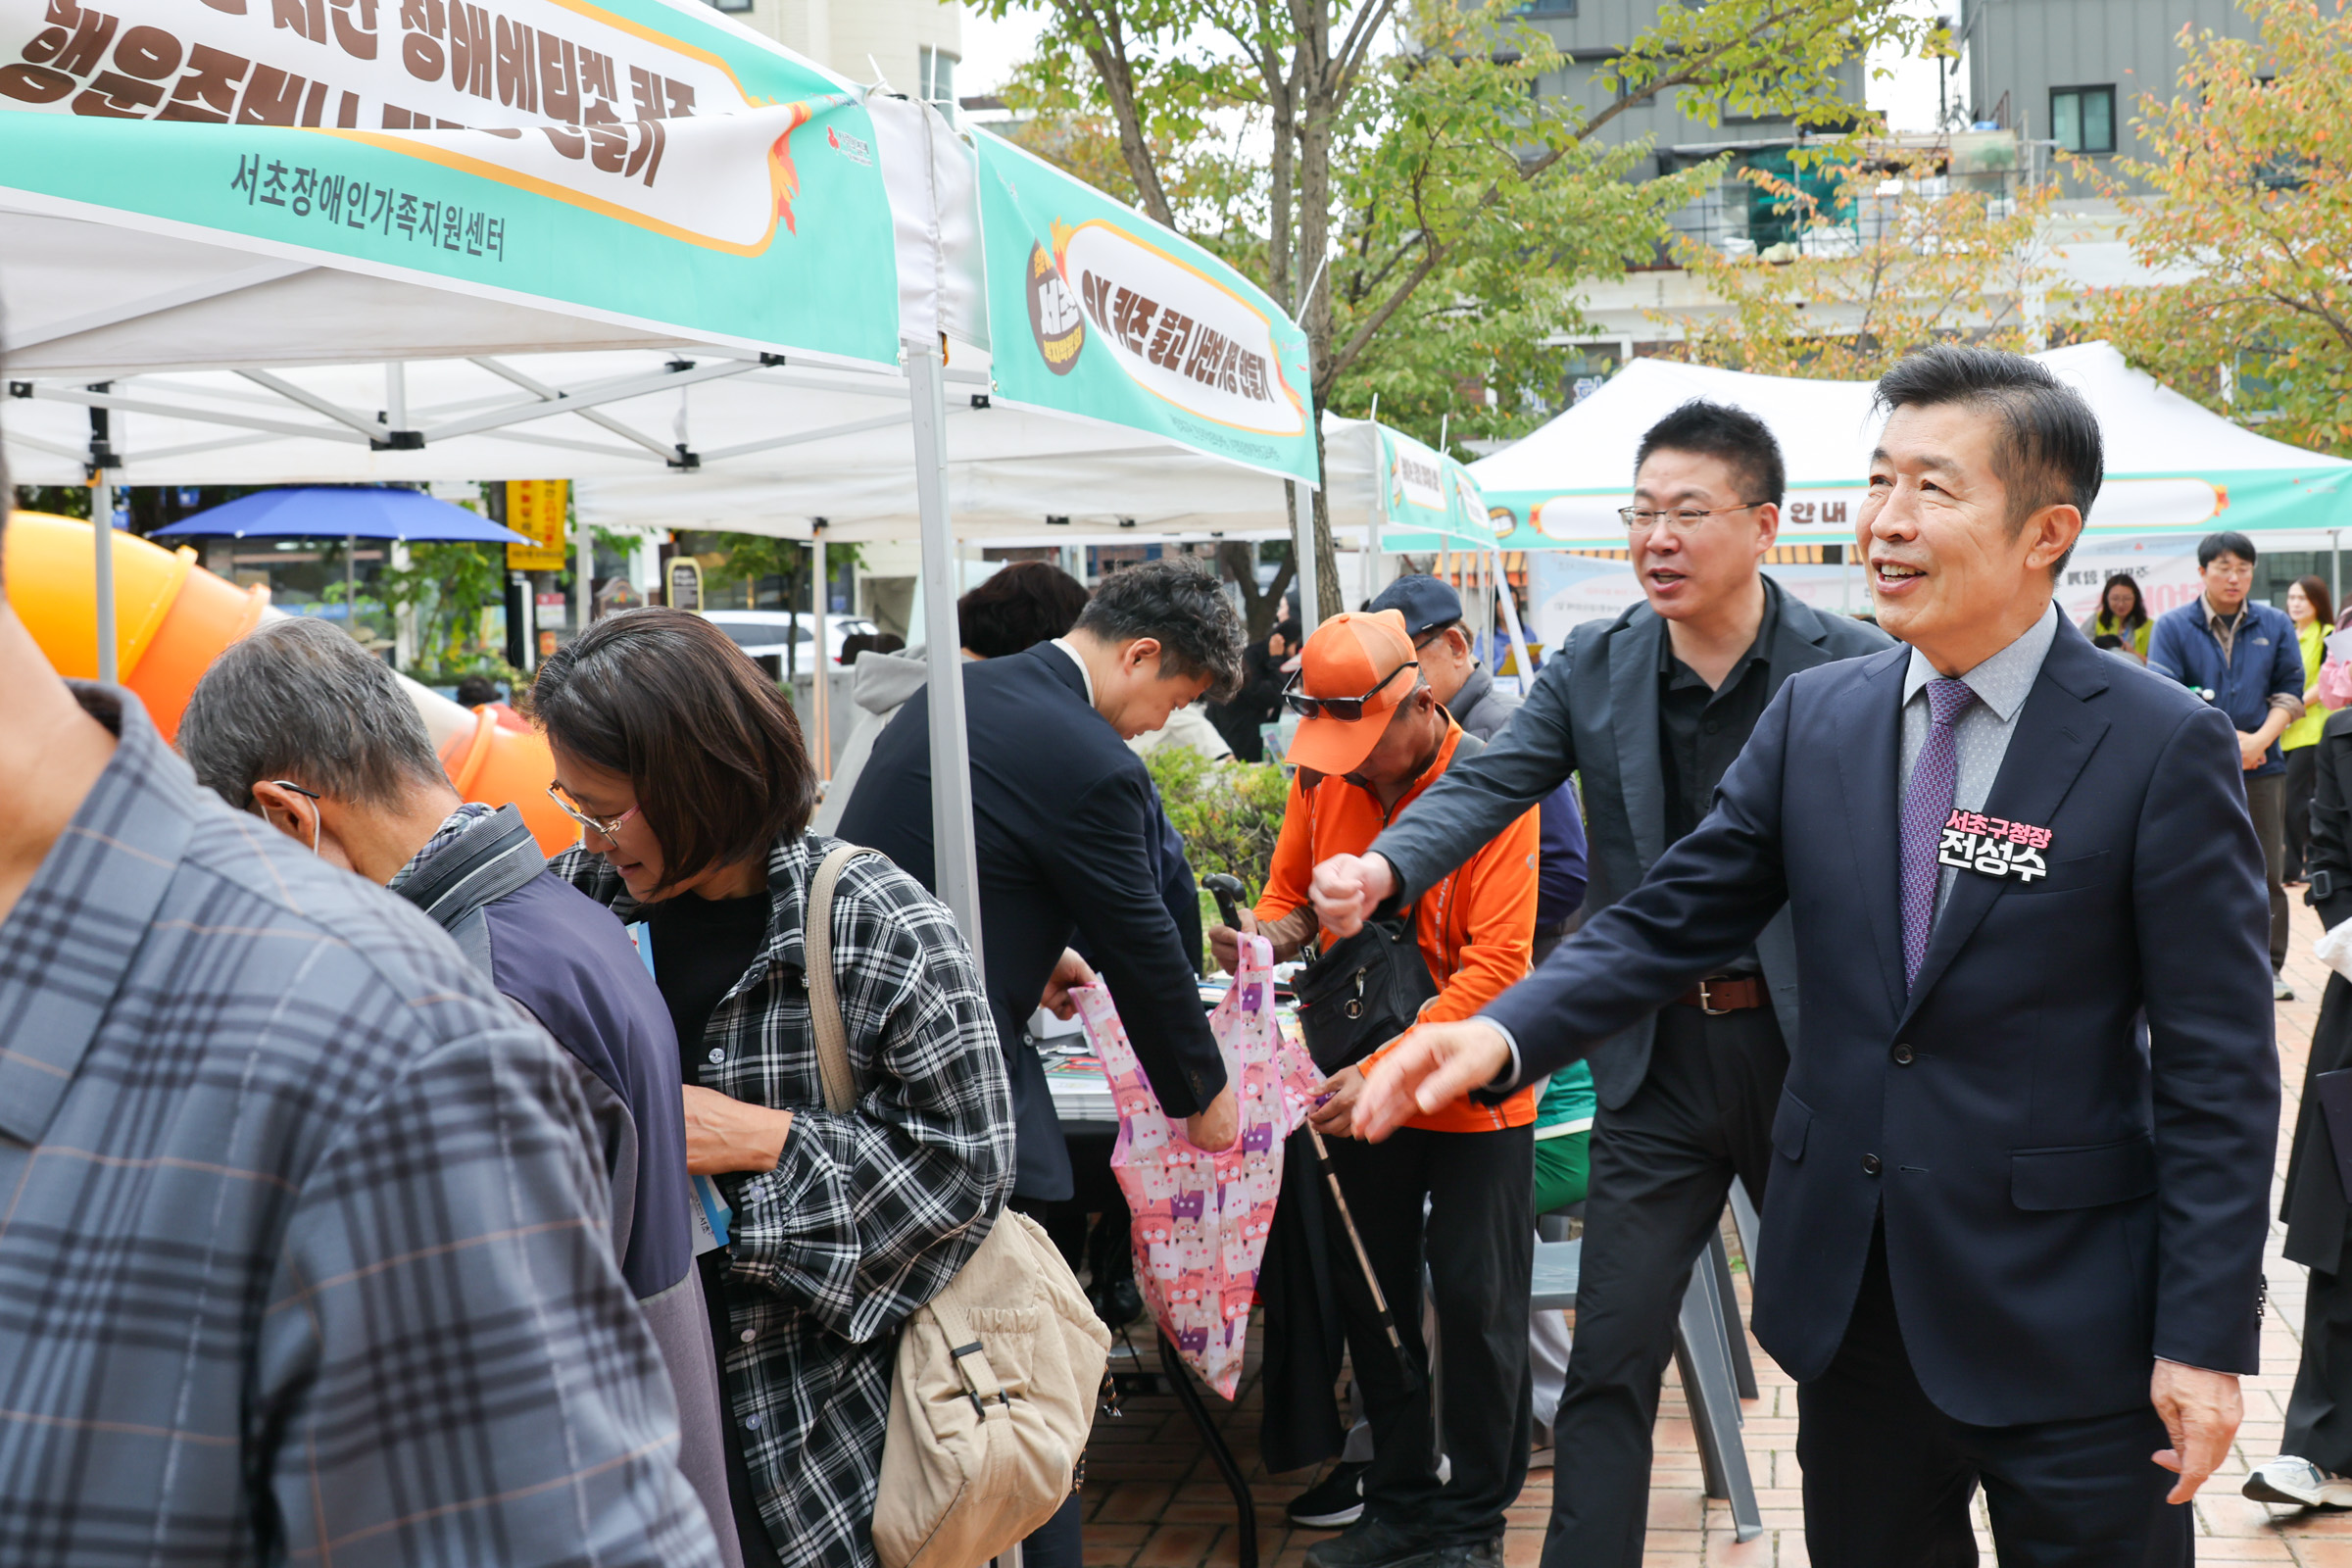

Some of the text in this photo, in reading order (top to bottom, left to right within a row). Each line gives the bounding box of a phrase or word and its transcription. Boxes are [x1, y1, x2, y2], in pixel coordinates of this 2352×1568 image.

[230, 153, 506, 263] 서초장애인가족지원센터
[1113, 286, 1159, 357] 퀴즈
[1148, 308, 1194, 371] 풀고
[1790, 501, 1846, 524] 안내
[1937, 829, 2047, 882] 전성수
[1945, 809, 2053, 850] 서초구청장
